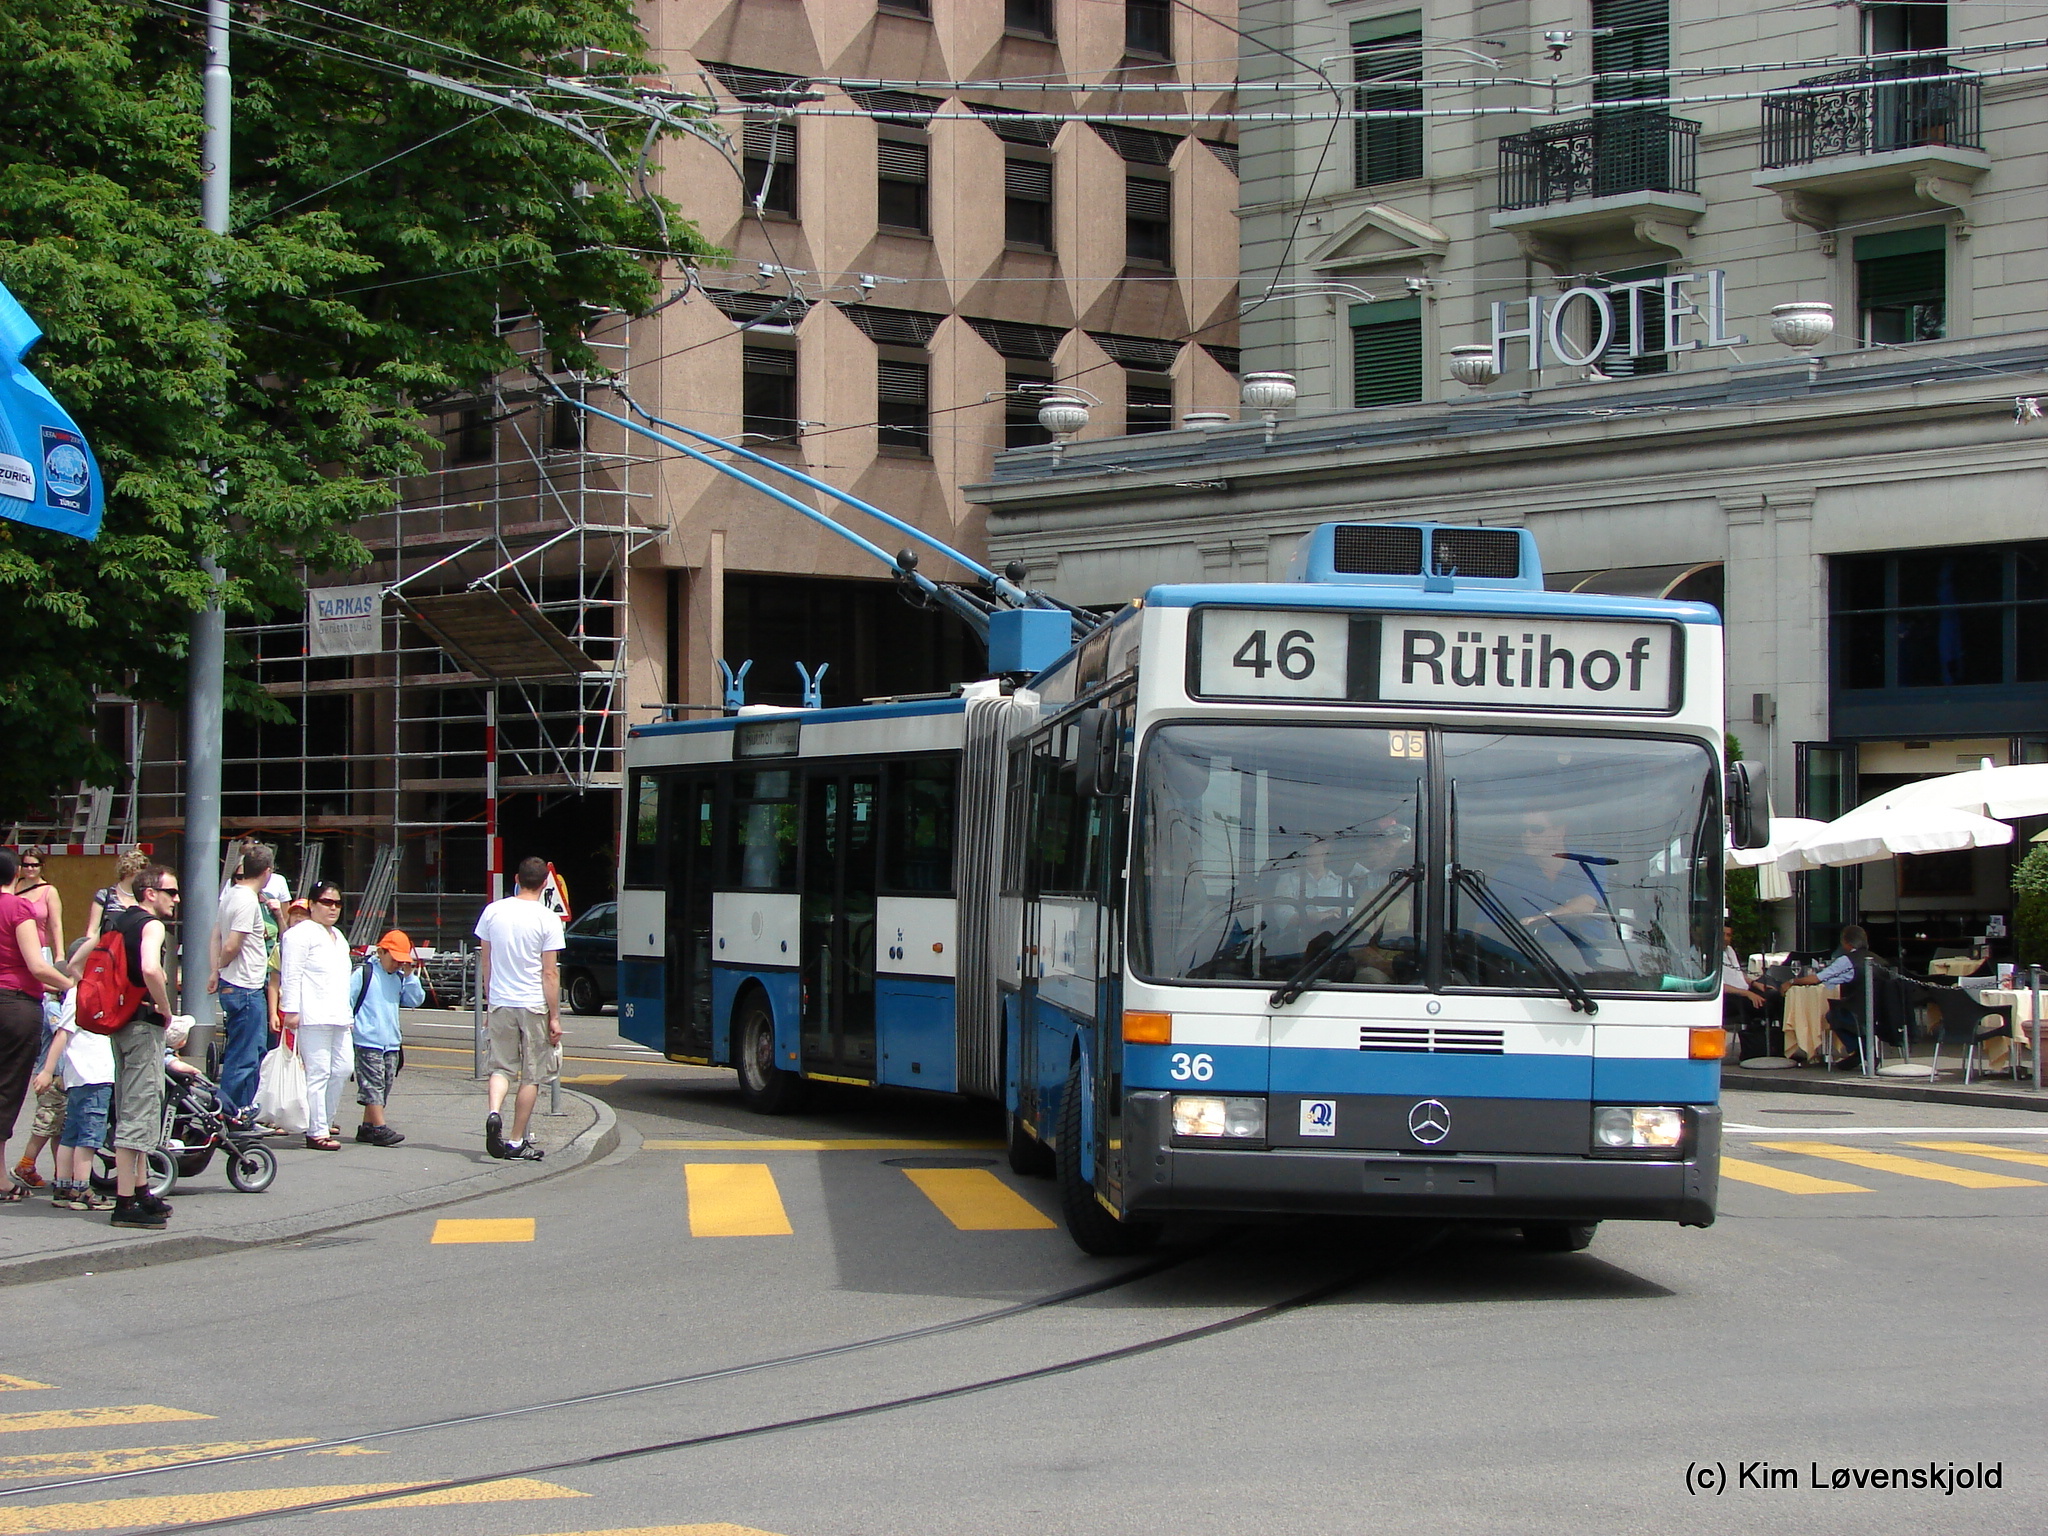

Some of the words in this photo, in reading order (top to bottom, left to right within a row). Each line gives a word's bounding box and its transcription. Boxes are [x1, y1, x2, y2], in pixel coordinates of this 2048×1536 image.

[1491, 269, 1748, 374] HOTEL
[318, 596, 372, 617] FARKAS
[1232, 629, 1316, 681] 46
[1401, 629, 1650, 692] Rütihof
[624, 1003, 635, 1018] 36
[1170, 1053, 1213, 1081] 36
